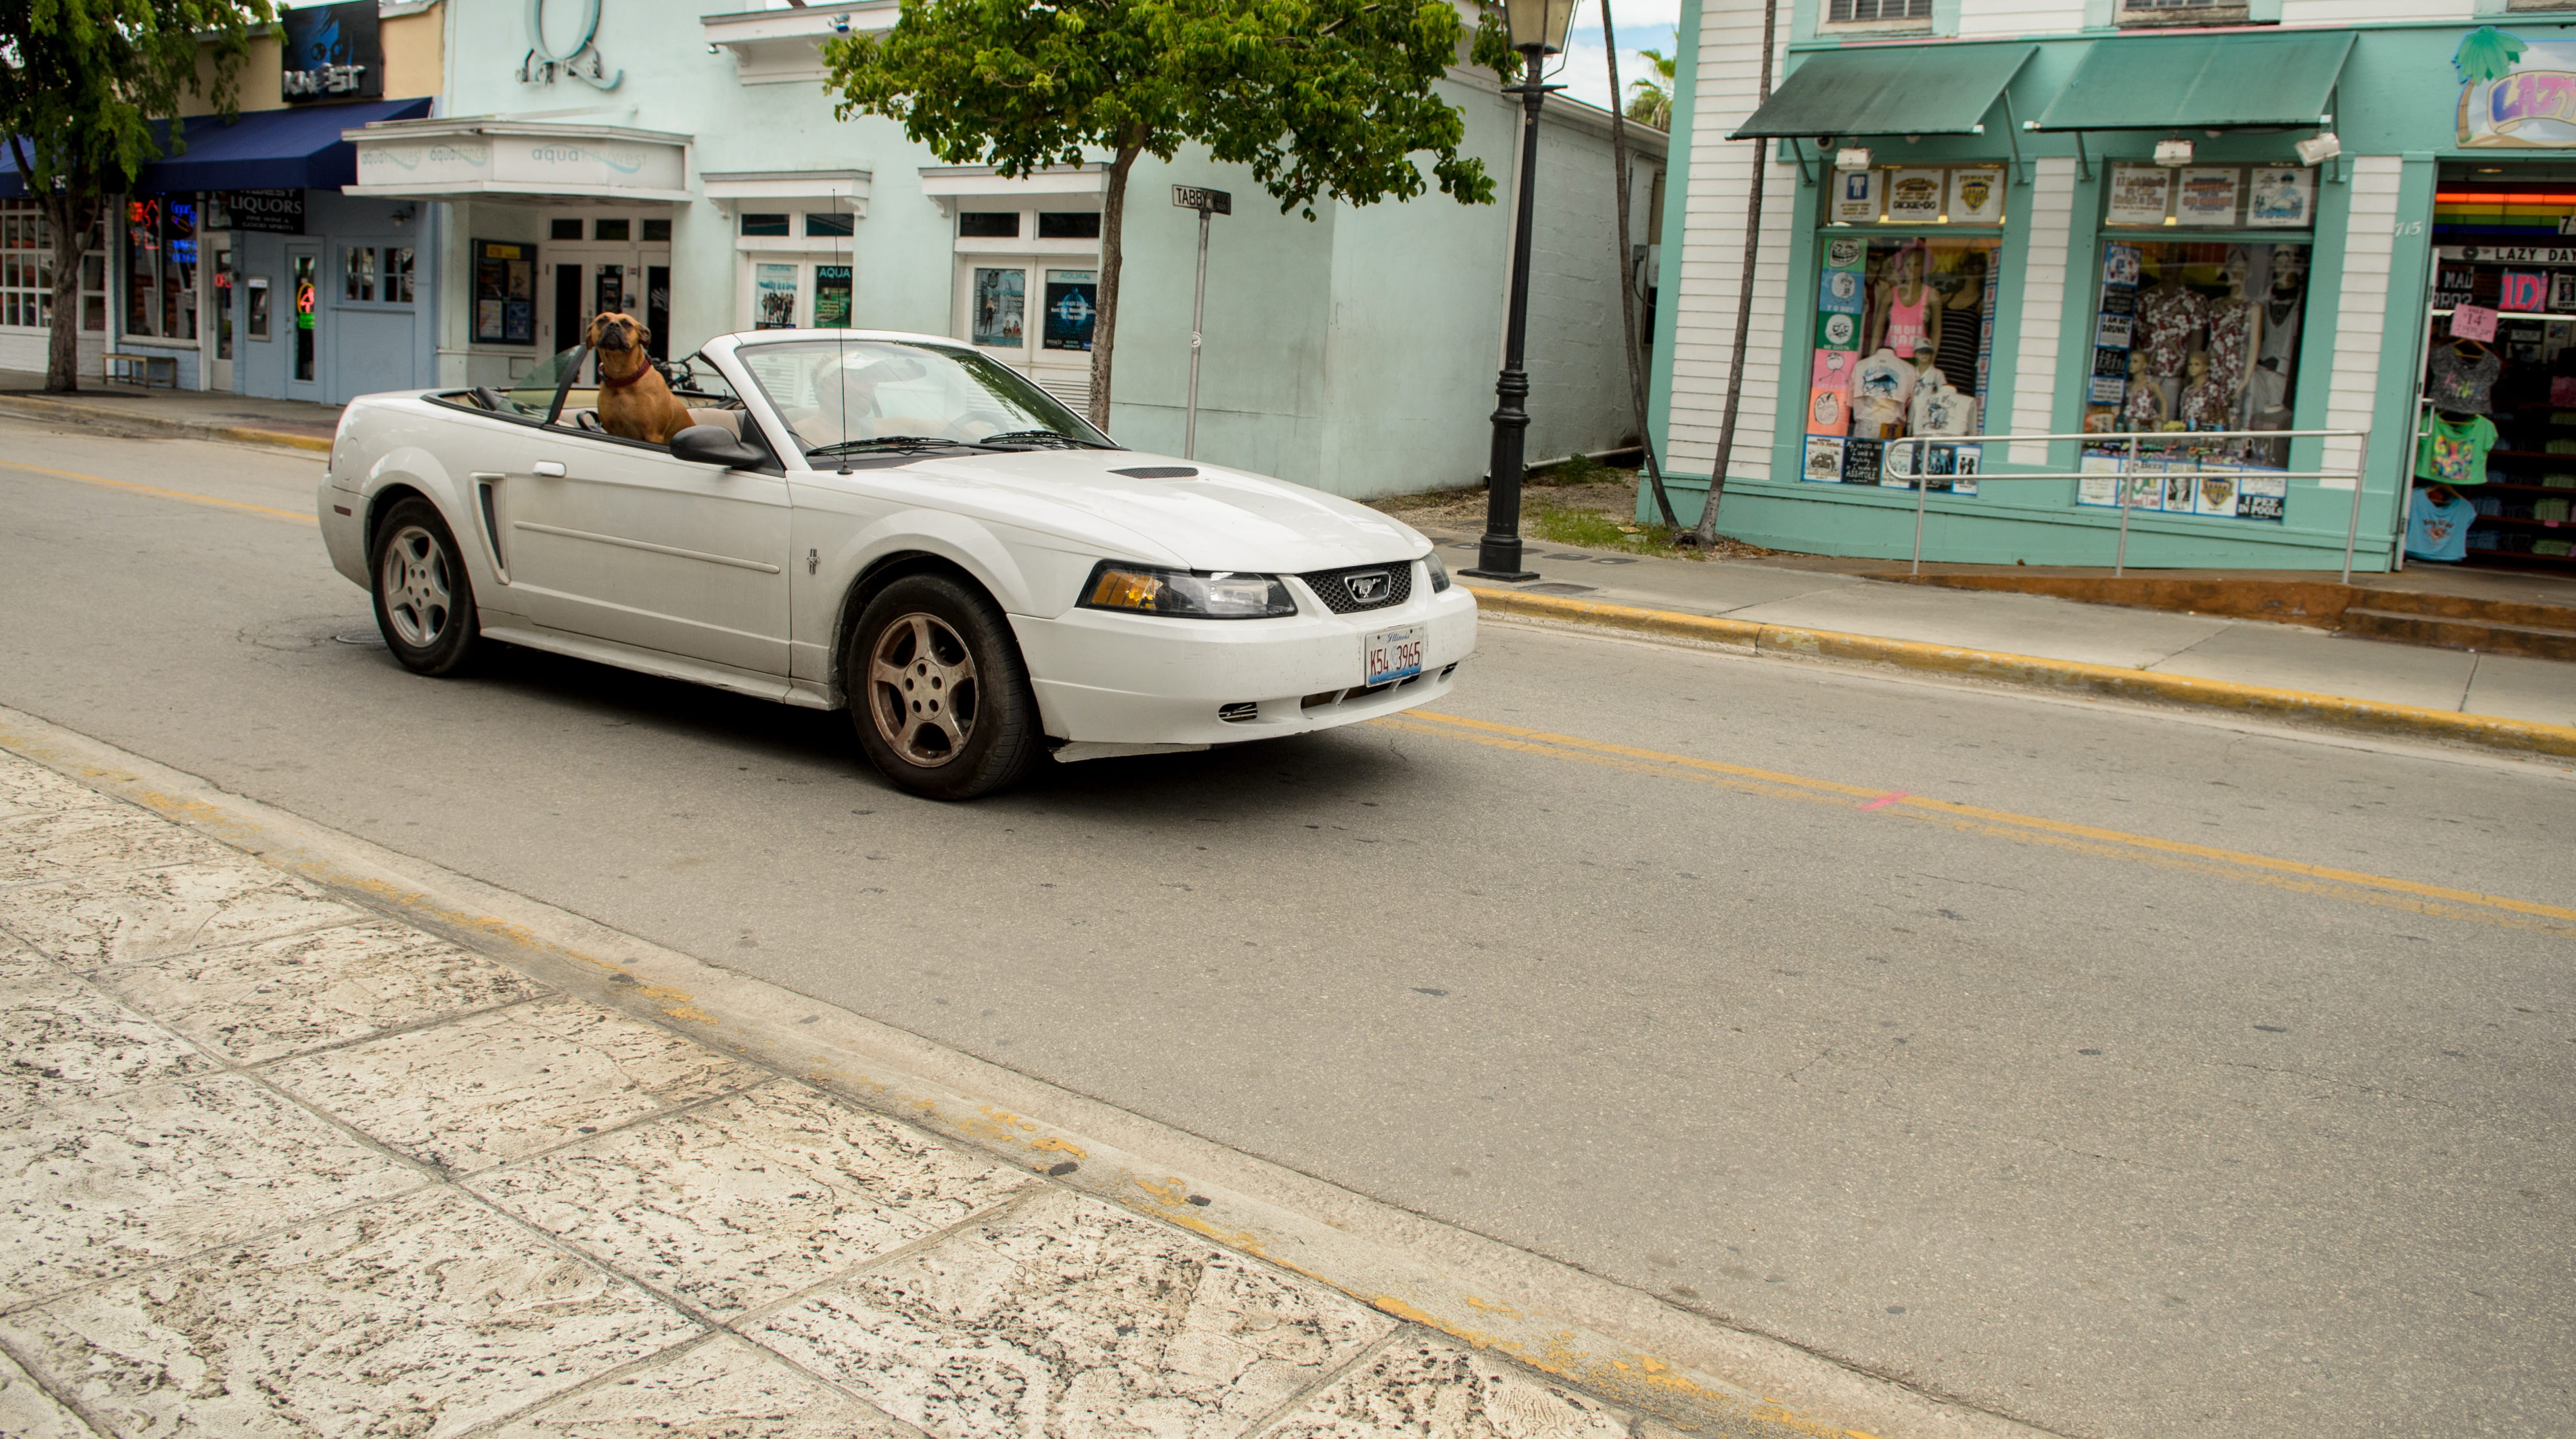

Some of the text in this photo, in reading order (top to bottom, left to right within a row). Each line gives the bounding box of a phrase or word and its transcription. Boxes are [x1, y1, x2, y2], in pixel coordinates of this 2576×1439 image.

[230, 195, 302, 214] LIQUORS
[1176, 188, 1208, 208] TABBY
[2395, 221, 2422, 237] 715
[2496, 248, 2536, 260] LAZY
[819, 267, 851, 278] AQUA
[1846, 470, 1876, 480] ASSHOLE
[2253, 497, 2278, 506] PEE
[2238, 503, 2284, 516] IN POOLS
[1381, 631, 1410, 644] Illinois
[1371, 641, 1420, 676] K54 3965
